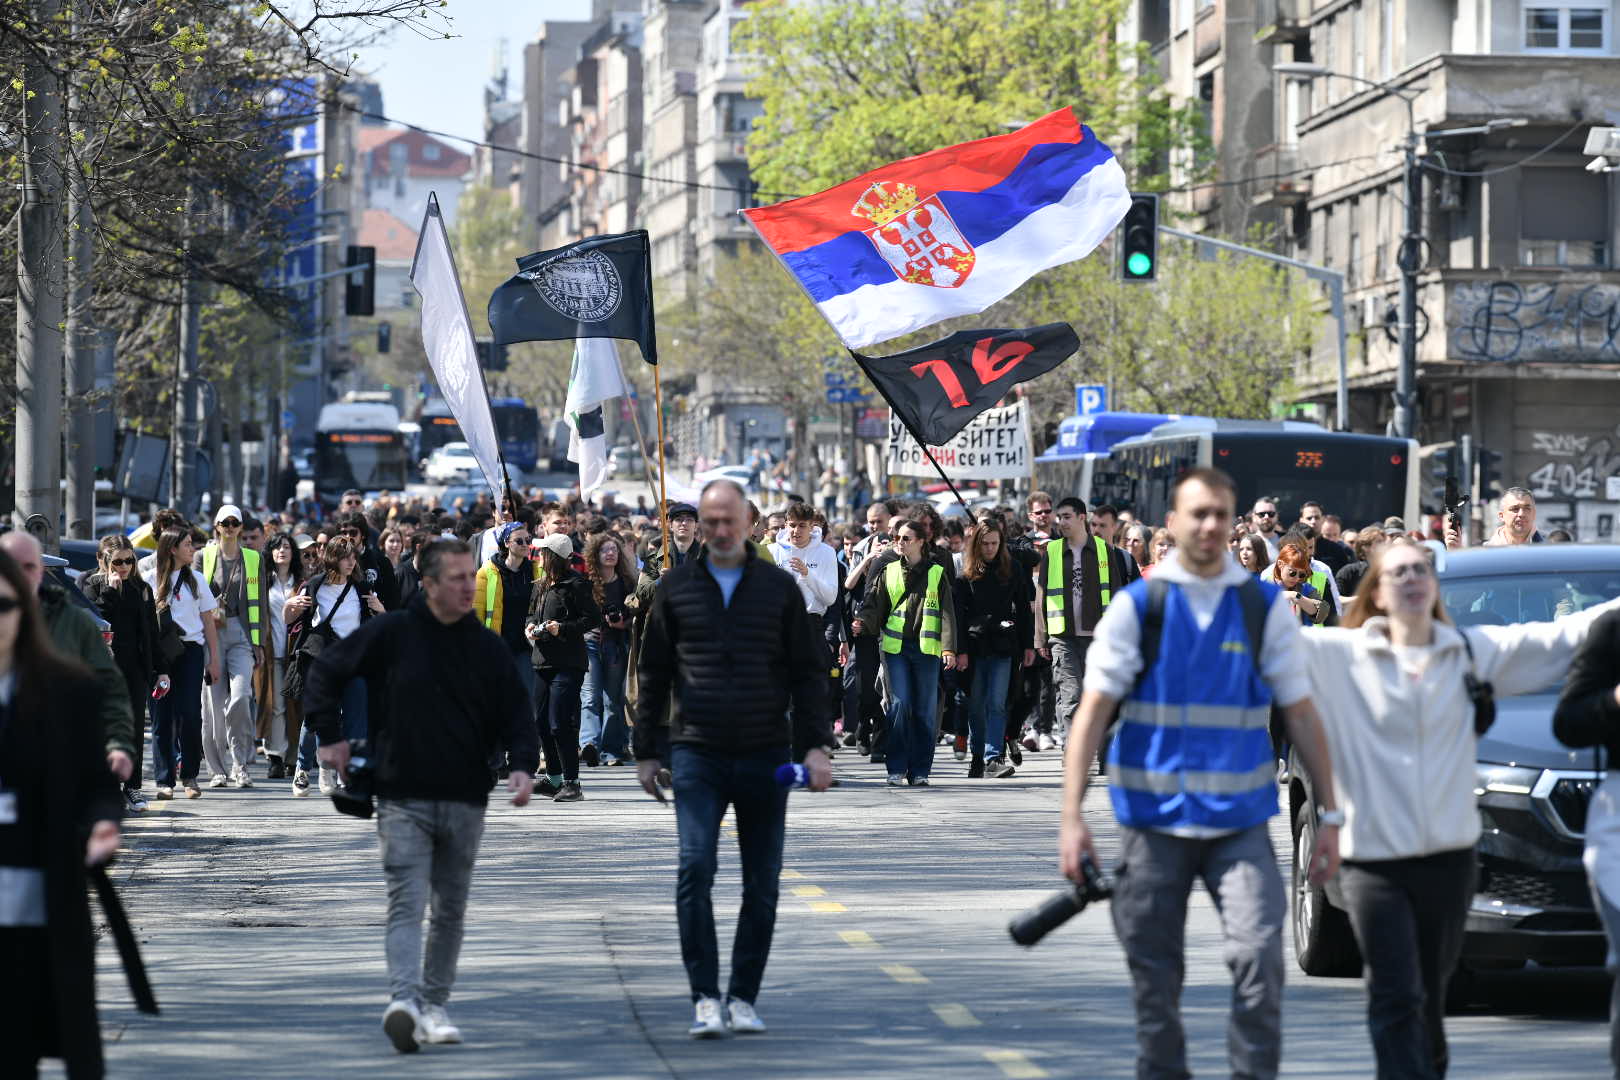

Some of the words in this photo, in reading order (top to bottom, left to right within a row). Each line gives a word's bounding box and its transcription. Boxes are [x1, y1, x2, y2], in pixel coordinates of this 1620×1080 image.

[909, 337, 1036, 408] 16
[1081, 389, 1100, 416] P
[1529, 463, 1598, 498] 404
